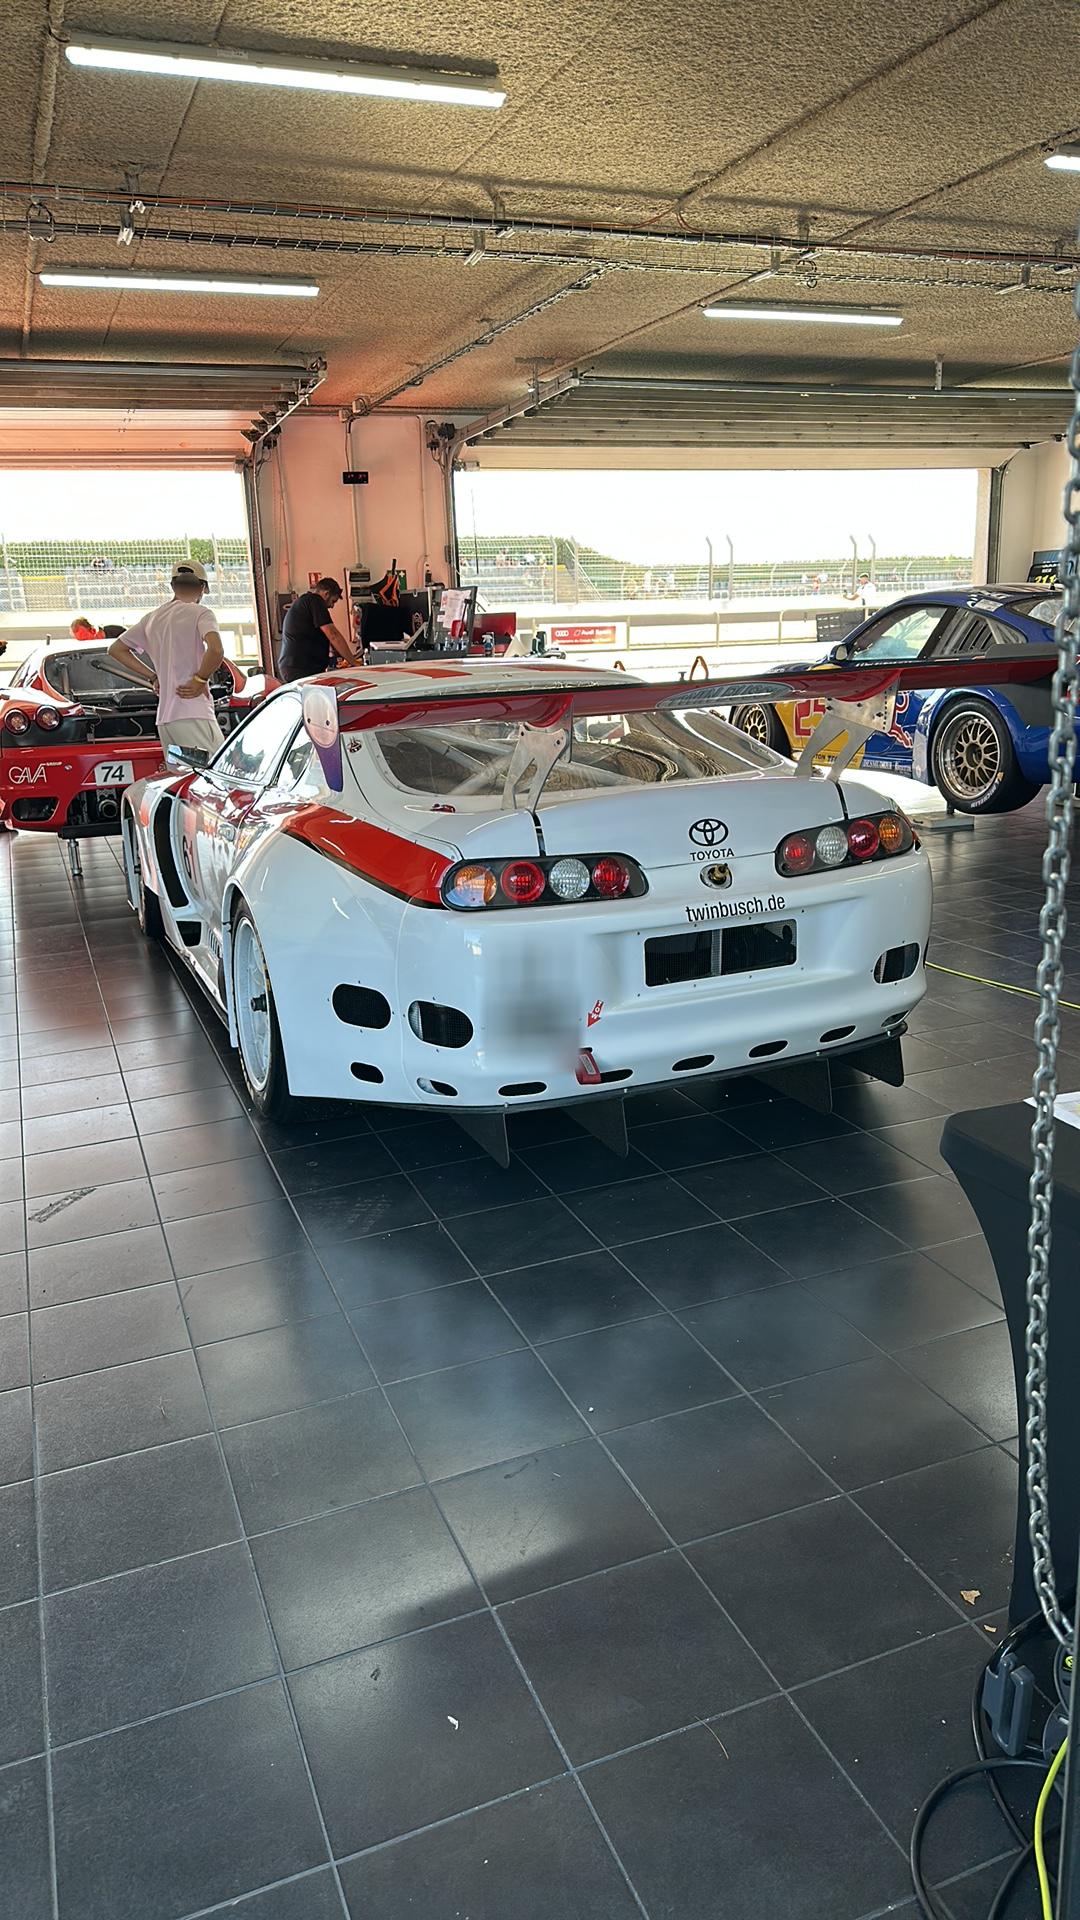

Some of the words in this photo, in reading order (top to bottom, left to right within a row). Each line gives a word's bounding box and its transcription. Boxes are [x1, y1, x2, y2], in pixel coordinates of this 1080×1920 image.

[101, 765, 125, 782] 74
[970, 783, 998, 809] MICHELIN
[689, 848, 735, 862] TOYOTA
[685, 894, 786, 922] twinbusch.de
[591, 1001, 602, 1019] TOW
